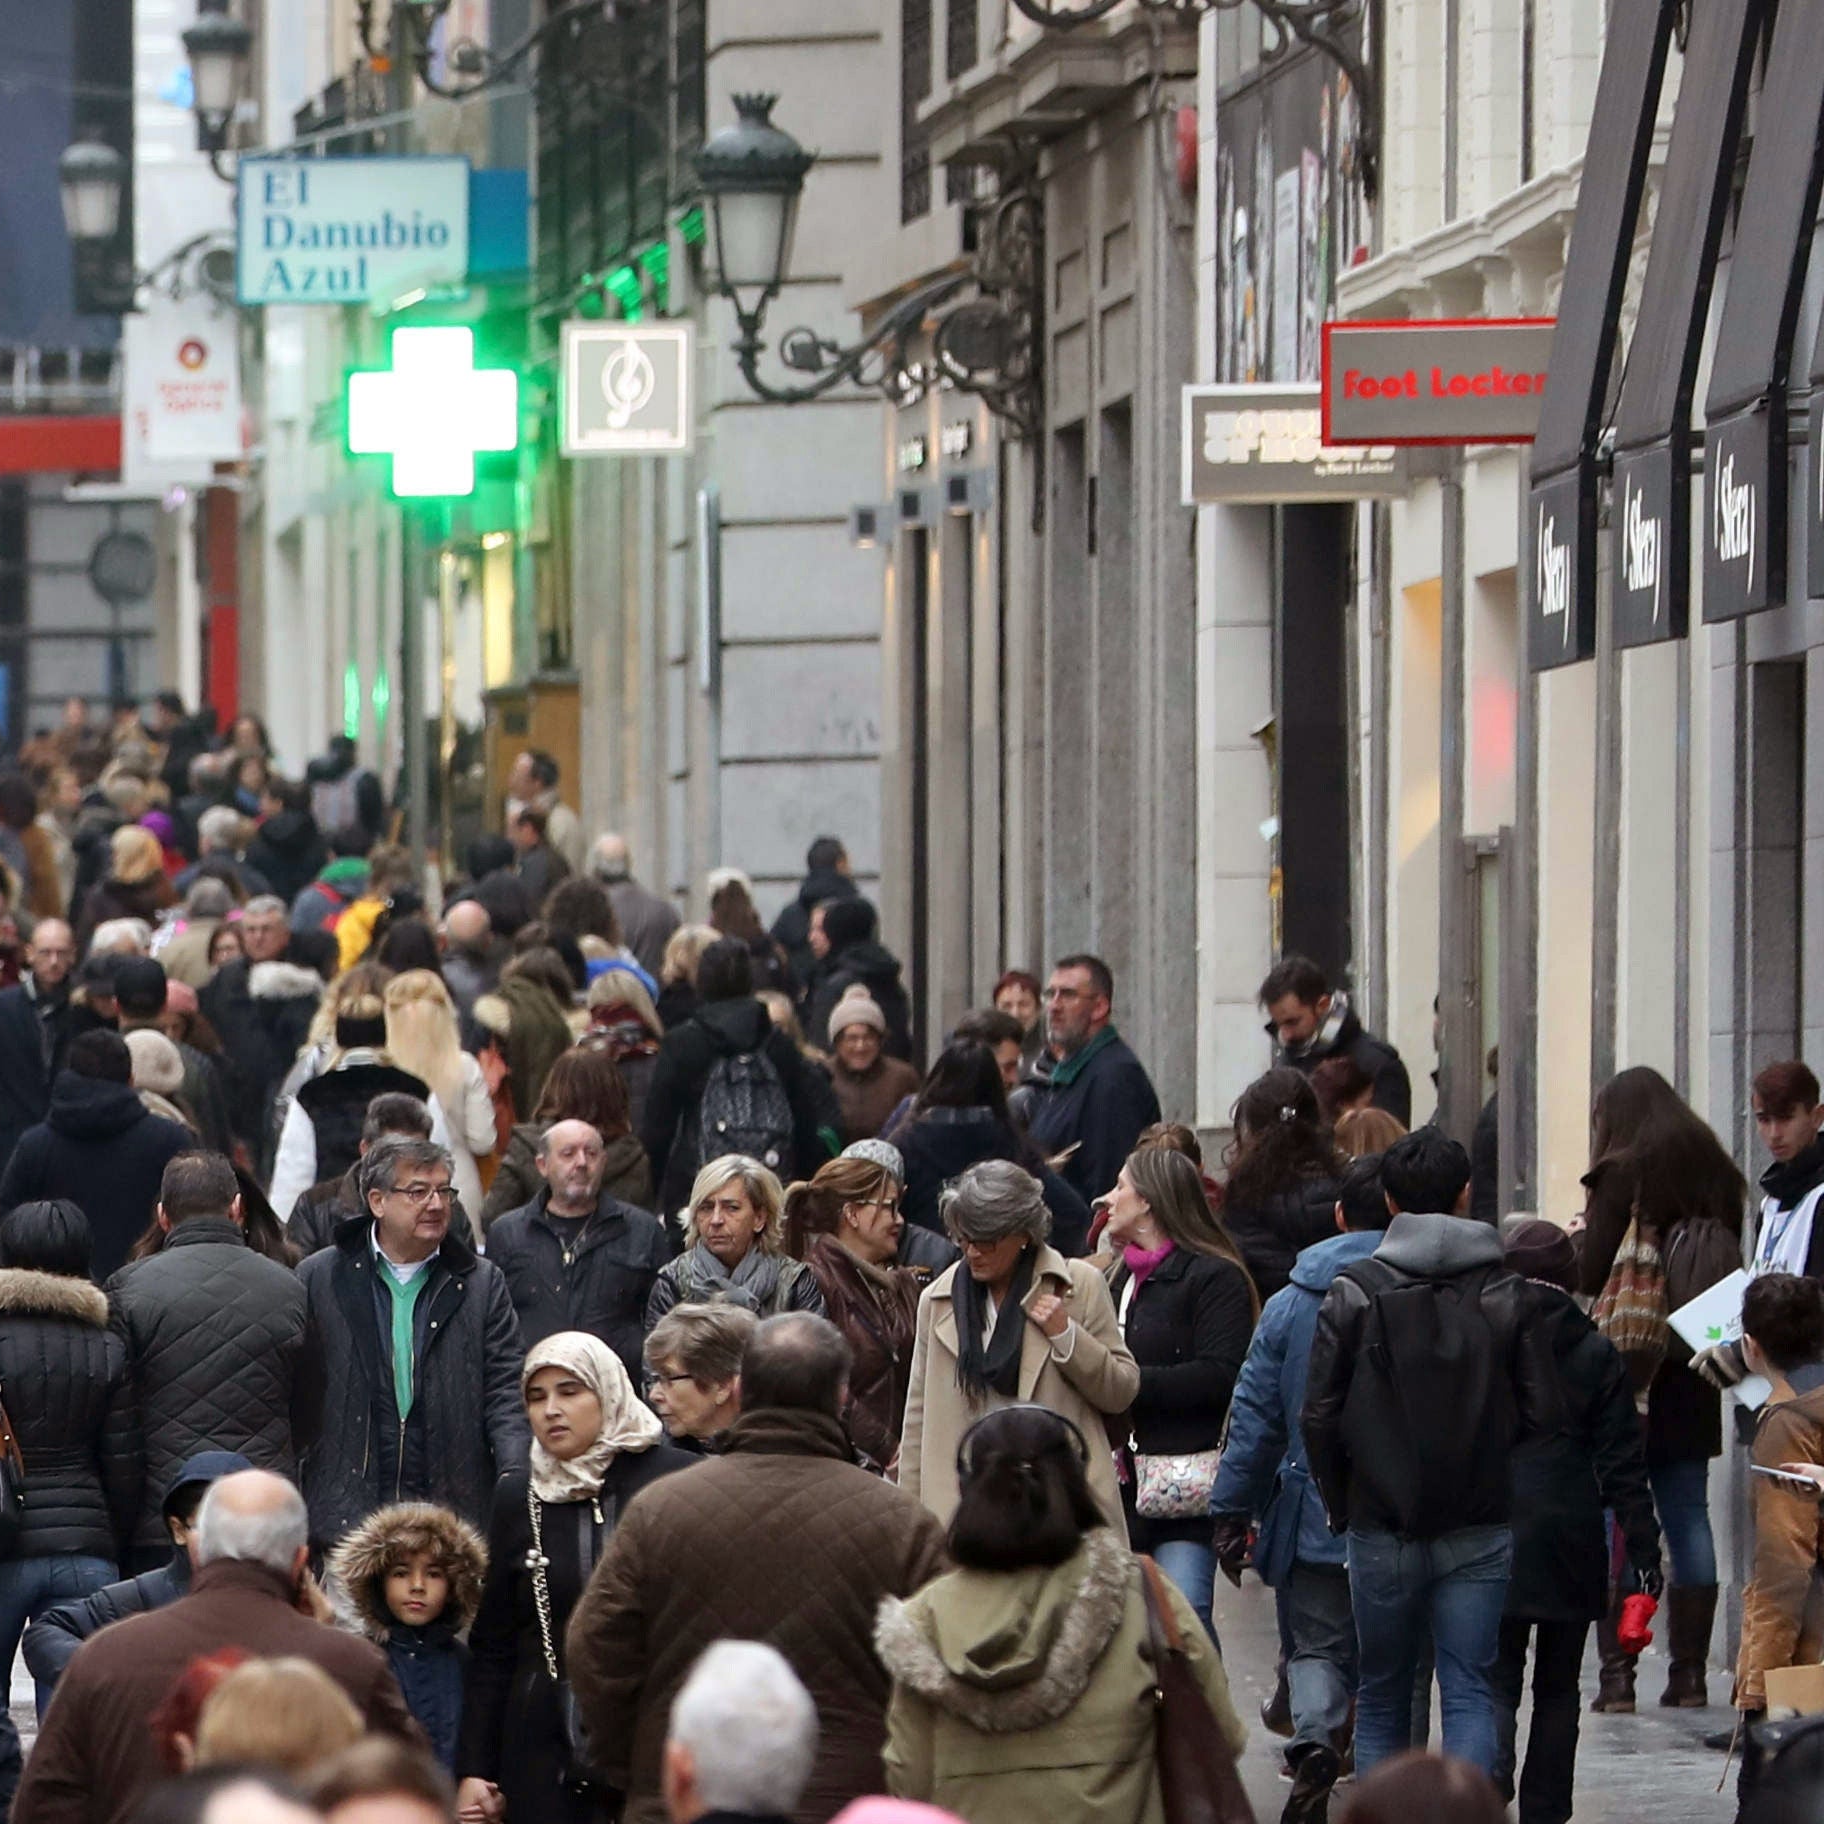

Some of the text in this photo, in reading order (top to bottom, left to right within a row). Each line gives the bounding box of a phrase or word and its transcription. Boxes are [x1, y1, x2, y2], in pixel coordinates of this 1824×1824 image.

[264, 169, 307, 207] El
[264, 210, 450, 249] Danubio
[260, 256, 368, 293] Azul
[1344, 366, 1548, 399] Foot Locker
